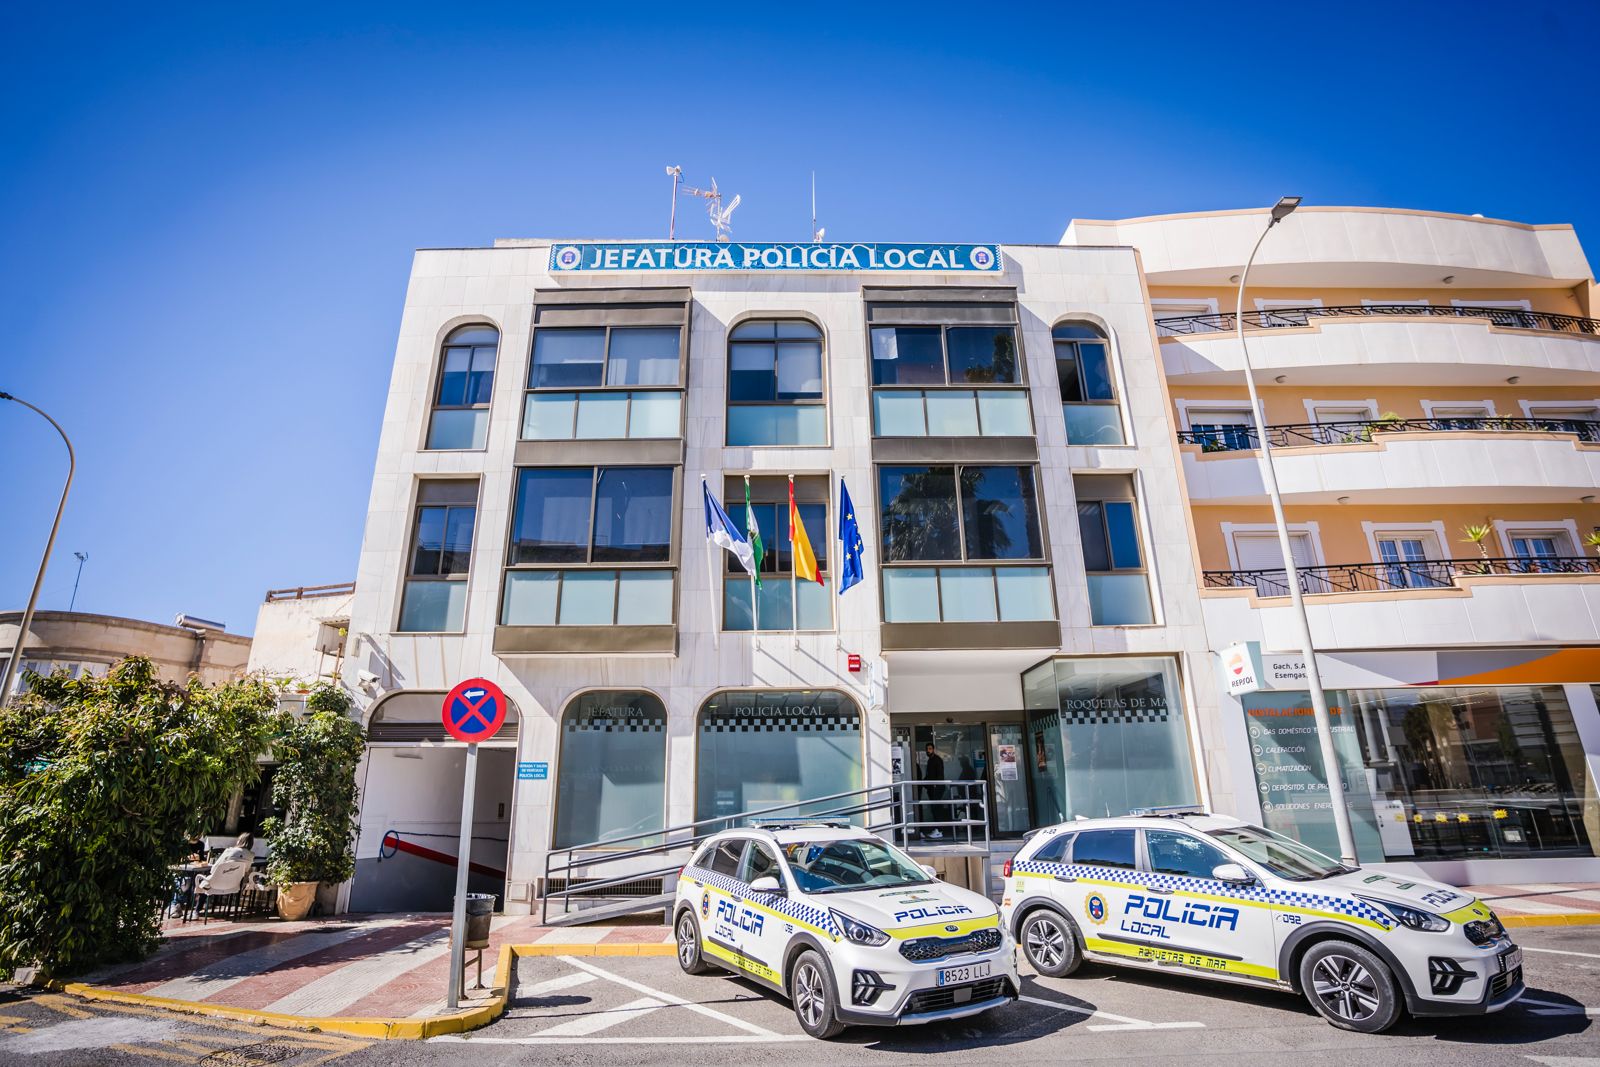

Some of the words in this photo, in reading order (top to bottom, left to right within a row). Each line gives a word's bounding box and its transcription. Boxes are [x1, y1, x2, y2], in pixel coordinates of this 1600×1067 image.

[591, 248, 735, 269] JEFATURA
[869, 248, 964, 269] LOCAL
[1231, 676, 1254, 687] REPSOL
[588, 706, 644, 717] JEFATURA
[735, 704, 782, 717] POLICÍA
[785, 706, 825, 716] LOCAL
[1066, 698, 1127, 711] ROQUETAS
[1130, 698, 1146, 708] DE
[1283, 914, 1301, 925] 092
[714, 923, 736, 942] LOCAL
[1121, 920, 1171, 939] LOCAL
[1189, 955, 1202, 966] DE
[1206, 958, 1227, 970] MAR
[945, 968, 970, 982] 8523
[973, 963, 991, 978] LLJ
